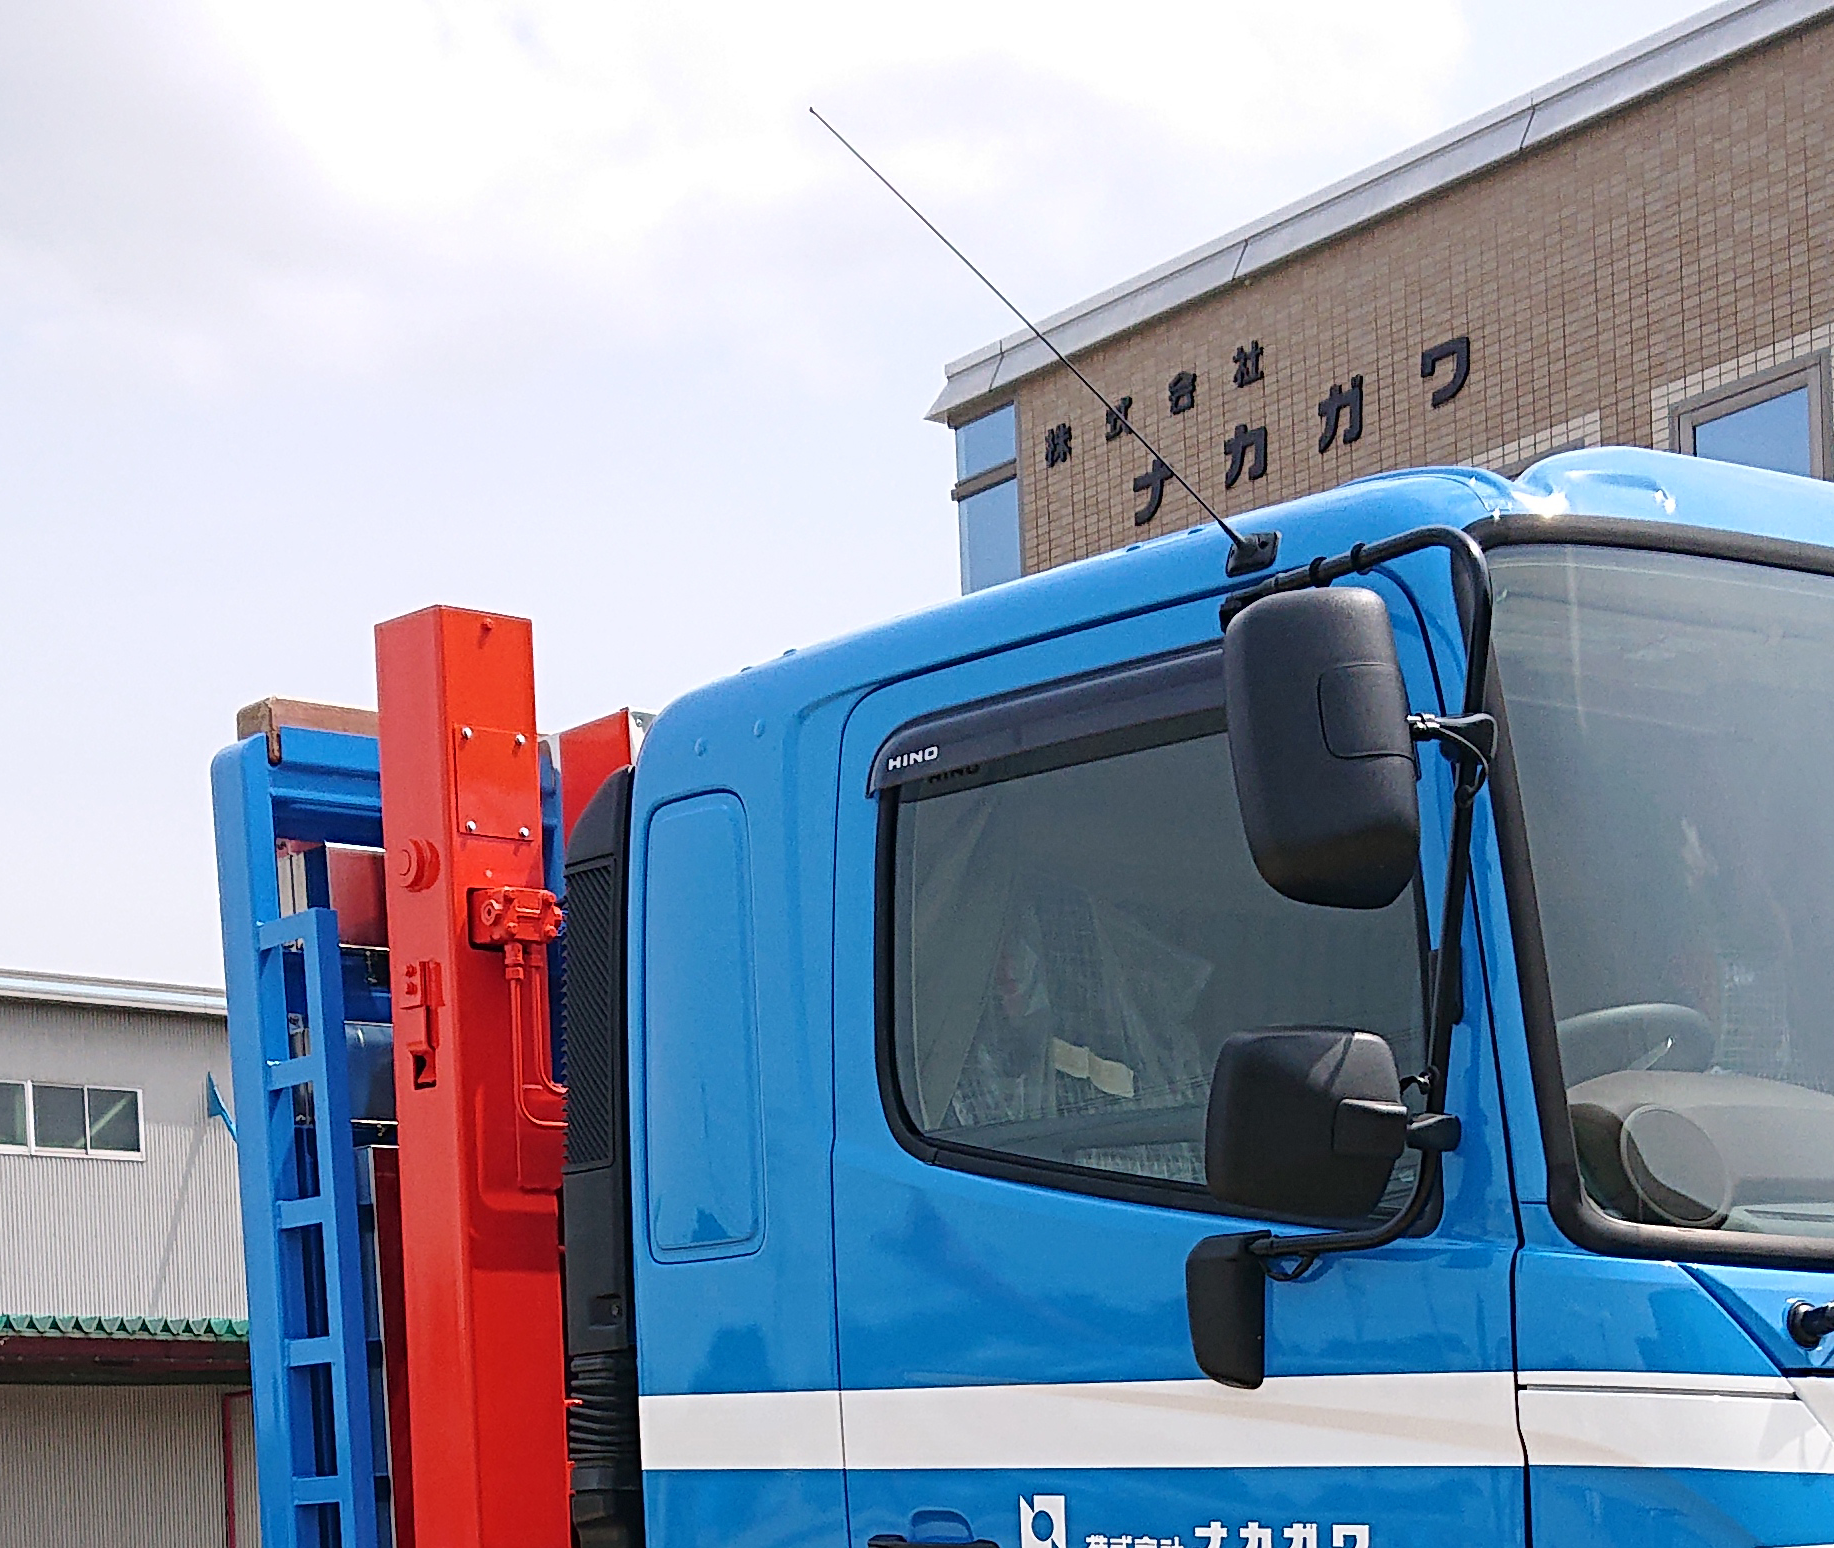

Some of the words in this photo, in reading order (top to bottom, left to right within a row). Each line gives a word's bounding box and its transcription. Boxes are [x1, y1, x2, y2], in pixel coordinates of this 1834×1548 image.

[1044, 339, 1264, 468] 株式会社
[1133, 336, 1470, 526] ナカガワ
[888, 745, 940, 771] HINO
